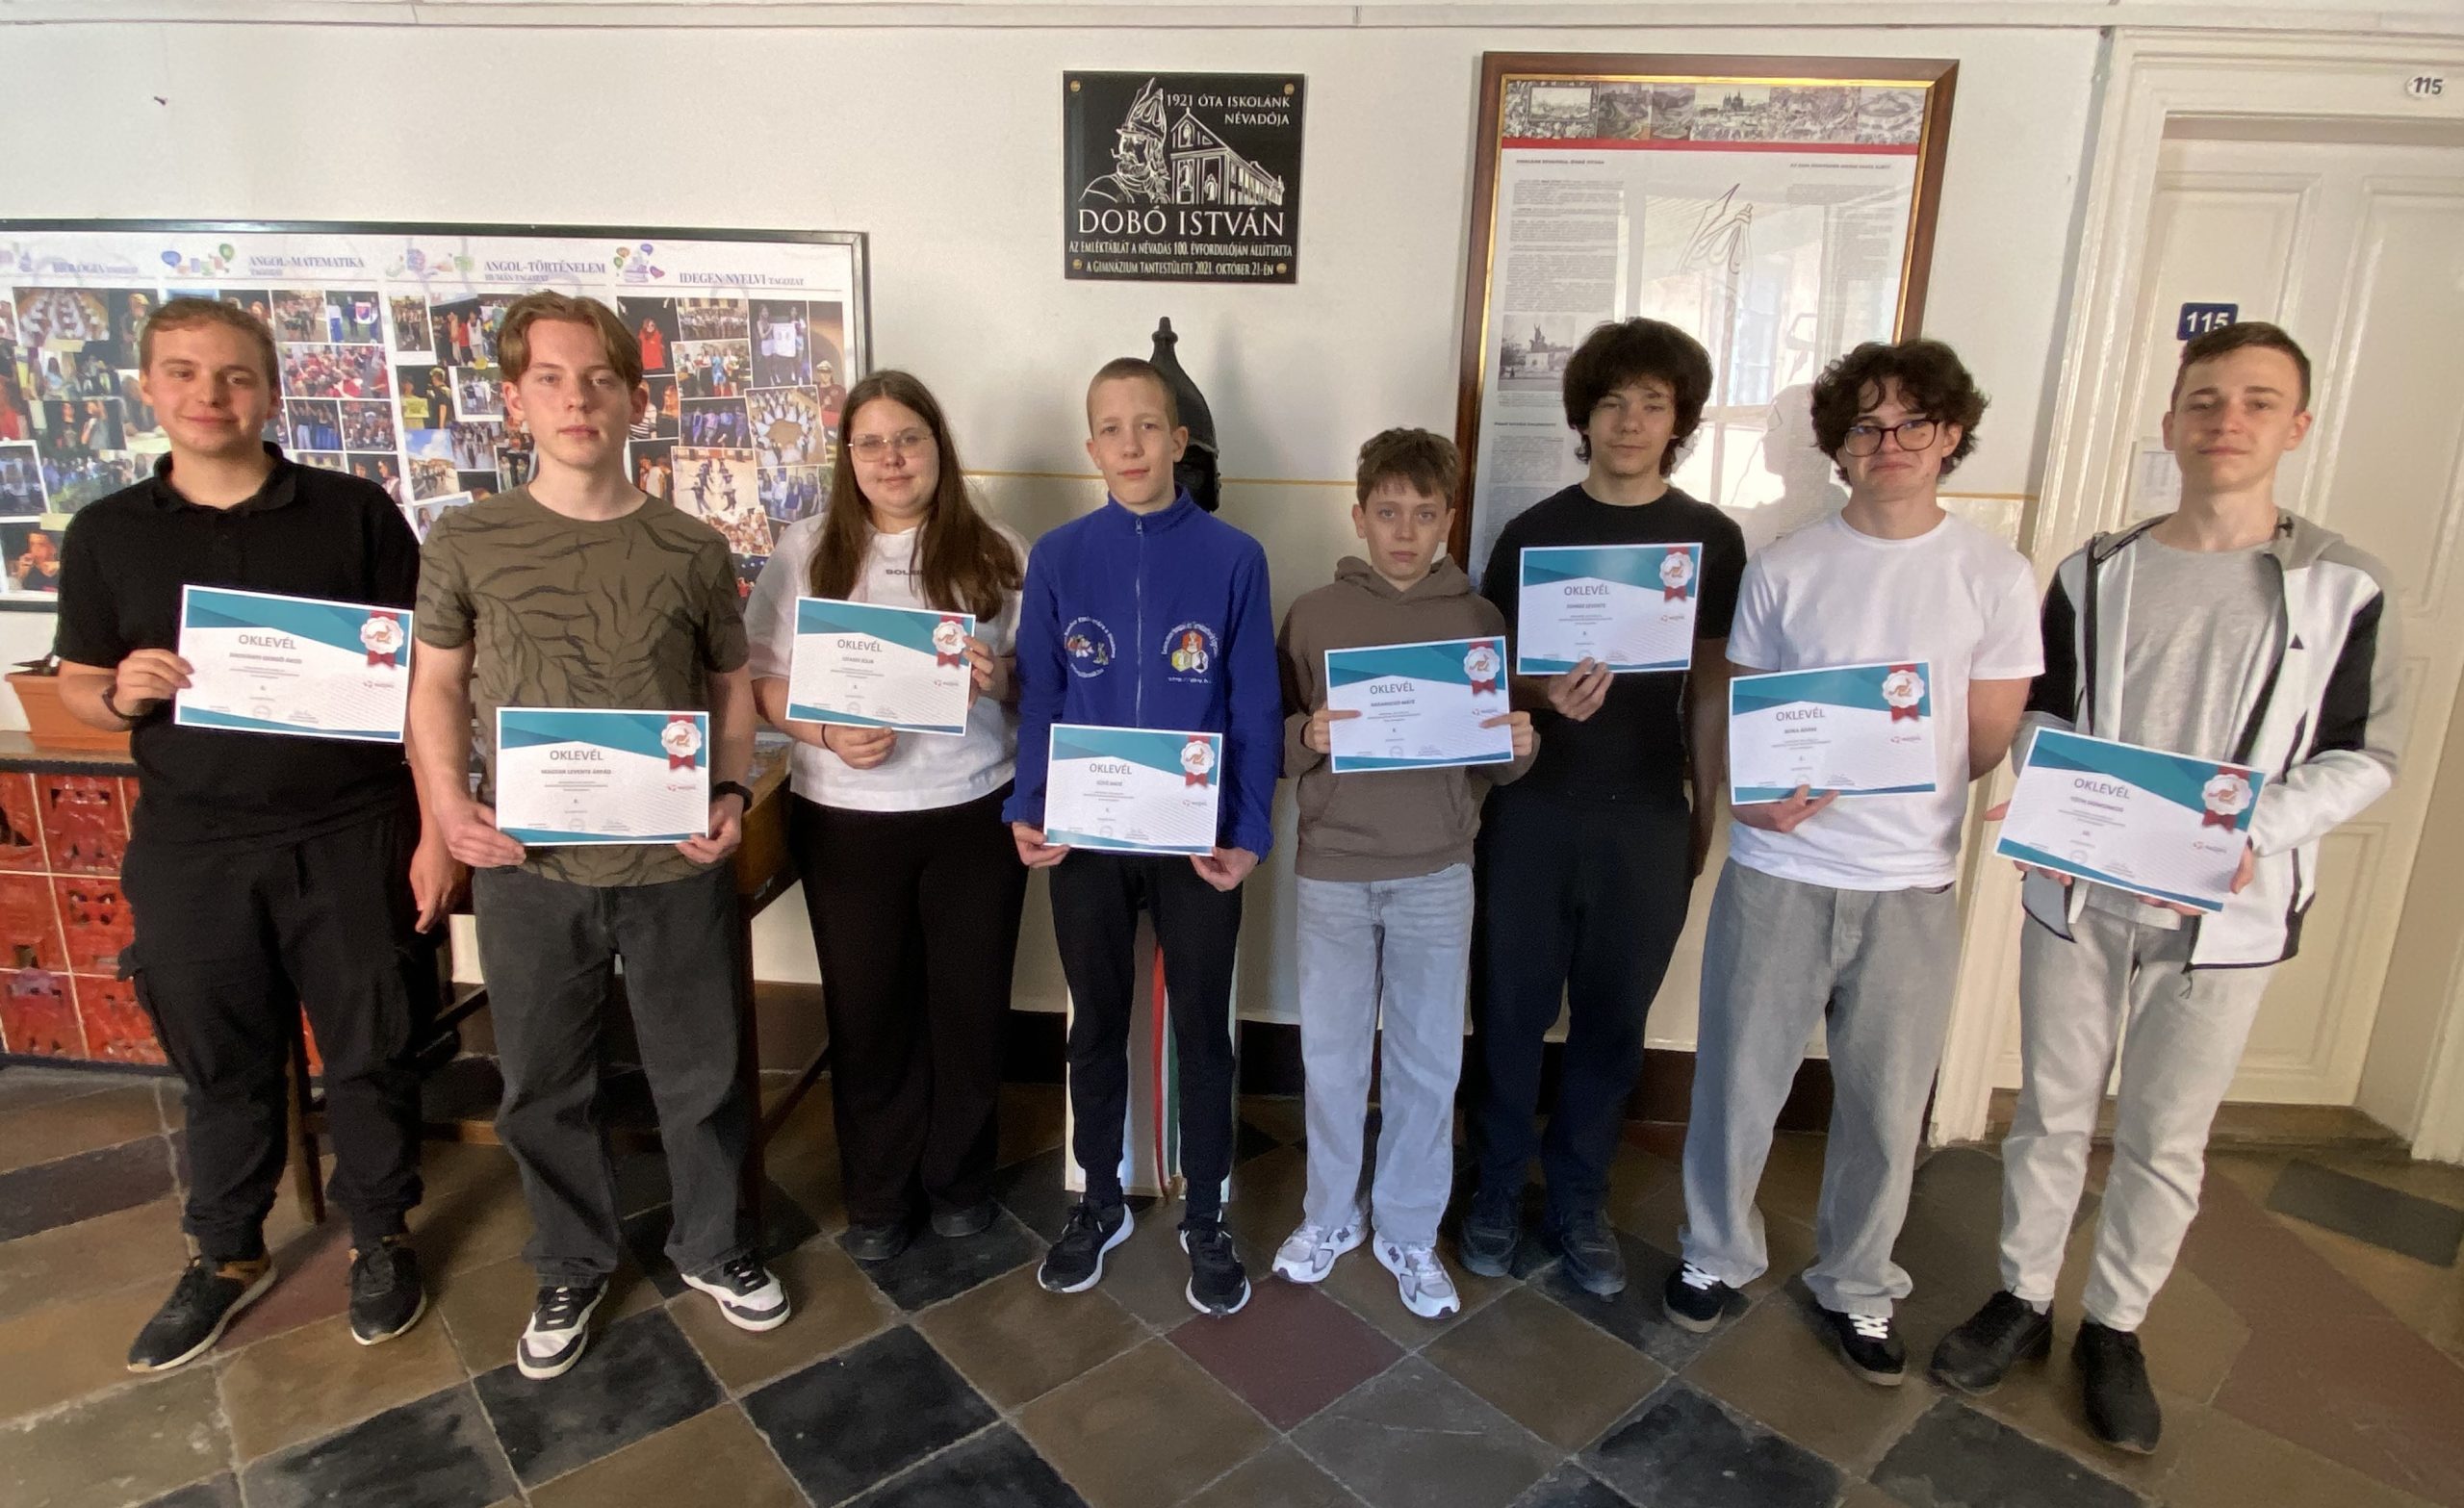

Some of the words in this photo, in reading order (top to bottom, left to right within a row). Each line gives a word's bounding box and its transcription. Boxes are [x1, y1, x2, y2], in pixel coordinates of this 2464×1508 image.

[2413, 76, 2444, 95] 115
[1167, 93, 1194, 107] 1921
[1197, 93, 1223, 108] ÓTA
[1227, 94, 1291, 109] ISKOLÁNK
[1224, 111, 1290, 127] NÉVADÓJA
[1078, 205, 1168, 235] DOBÓ
[1178, 207, 1285, 237] ISTVÁN
[1068, 240, 1079, 253] AZ
[1081, 240, 1129, 254] EMLÉKTÁBLÁT
[1131, 243, 1138, 254] A
[1138, 240, 1172, 255] NÉVADÁS
[1173, 242, 1190, 256] 100.
[1191, 241, 1249, 258] ÉVFORDULÓJÁN
[484, 259, 606, 273] ANGOL-TÖRTÉNELEM
[1086, 261, 1092, 272] A
[1092, 259, 1139, 274] GIMNÁZIUM
[1194, 261, 1214, 275] 2021.
[1251, 262, 1274, 276] 21-ÉN
[680, 272, 723, 284] IDEGEN
[724, 273, 767, 285] NYELVI
[2186, 311, 2229, 333] 115
[1564, 582, 1610, 596] OKLEVÉL
[238, 633, 296, 650] OKLEVÉL
[837, 638, 883, 652] OKLEVÉL
[1370, 680, 1415, 695] OKLEVÉL
[1776, 706, 1825, 722] OKLEVÉL
[550, 749, 603, 761] OKLEVÉL
[1089, 762, 1132, 775] OKLEVÉL
[2073, 777, 2131, 800] OKLEVÉL
